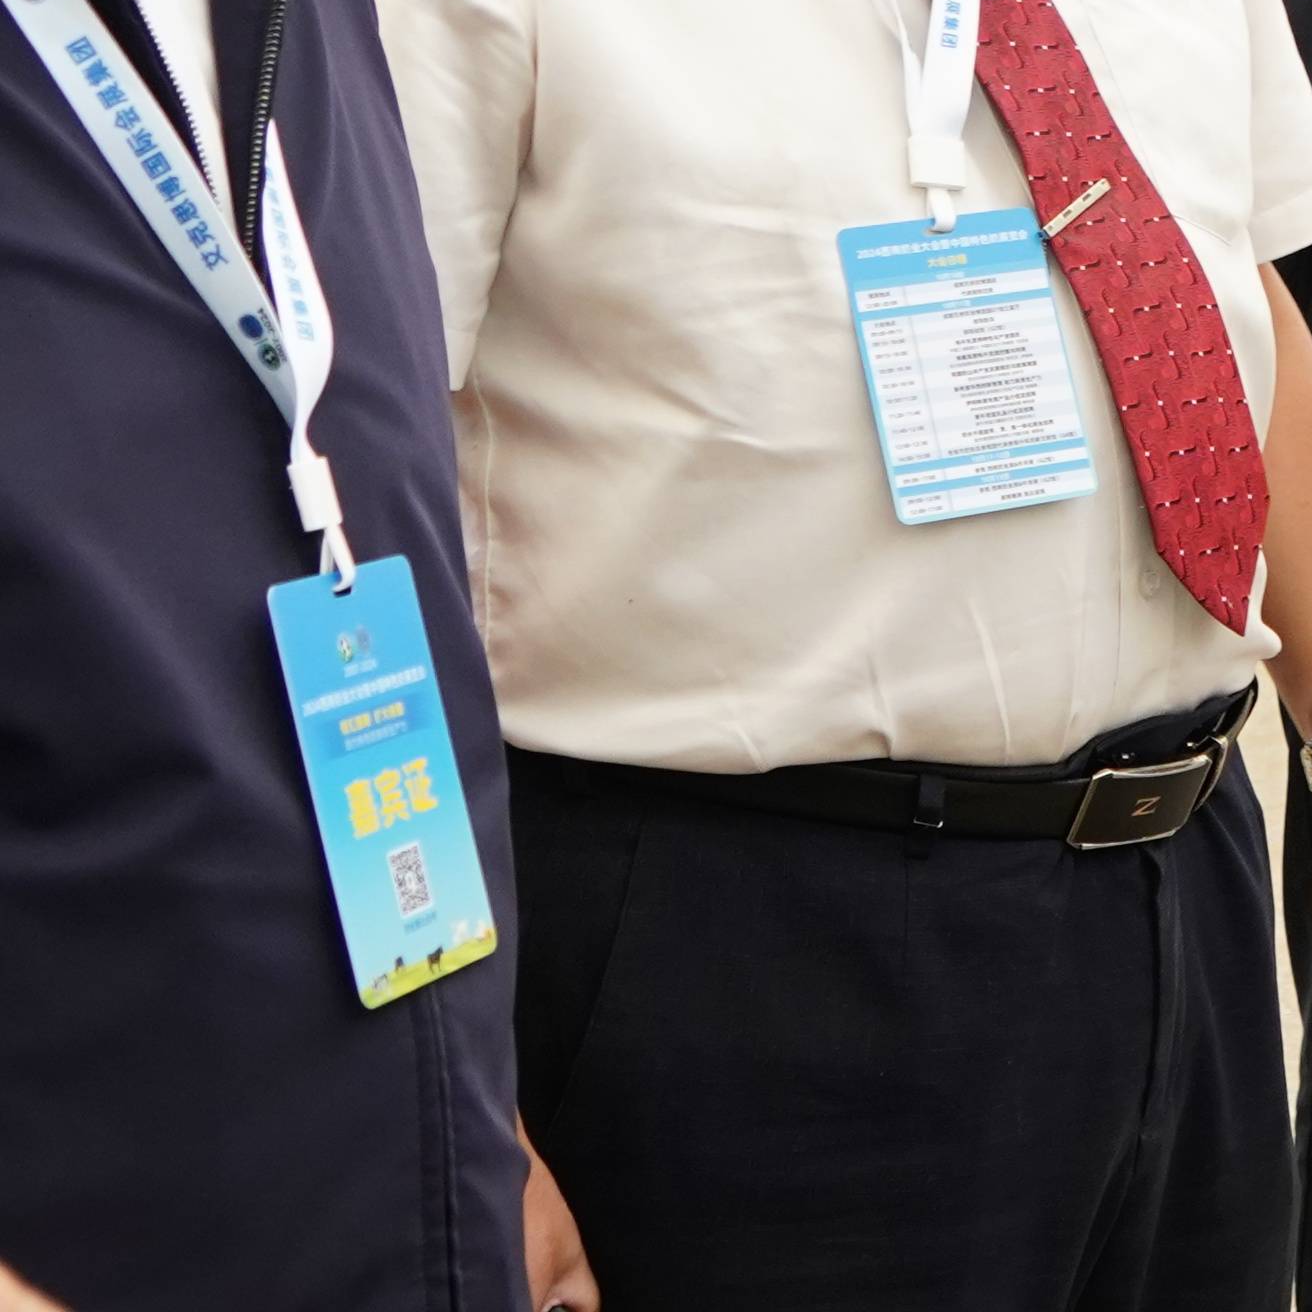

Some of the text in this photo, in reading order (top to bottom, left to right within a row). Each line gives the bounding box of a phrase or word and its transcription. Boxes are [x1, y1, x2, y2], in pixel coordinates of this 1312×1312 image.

[66, 34, 230, 272] 艾克思博国际会展集团
